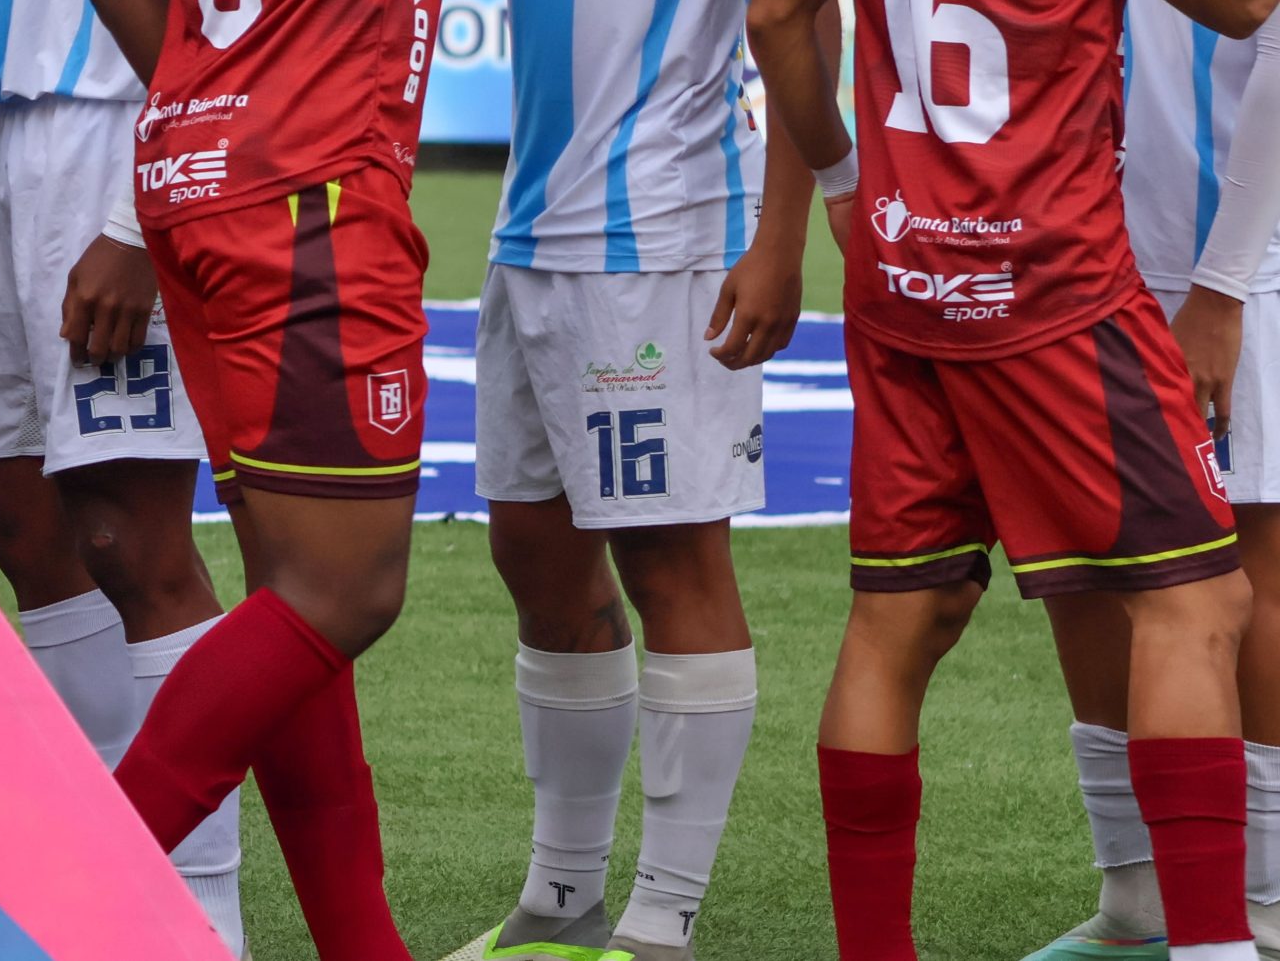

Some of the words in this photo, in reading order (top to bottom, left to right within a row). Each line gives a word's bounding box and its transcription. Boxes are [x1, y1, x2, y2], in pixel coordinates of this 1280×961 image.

[137, 149, 228, 192] TOKE
[169, 182, 221, 203] sport
[878, 261, 1015, 303] TOKE
[943, 303, 1011, 323] sport
[596, 366, 666, 383] Cañaveral
[73, 344, 176, 438] 29
